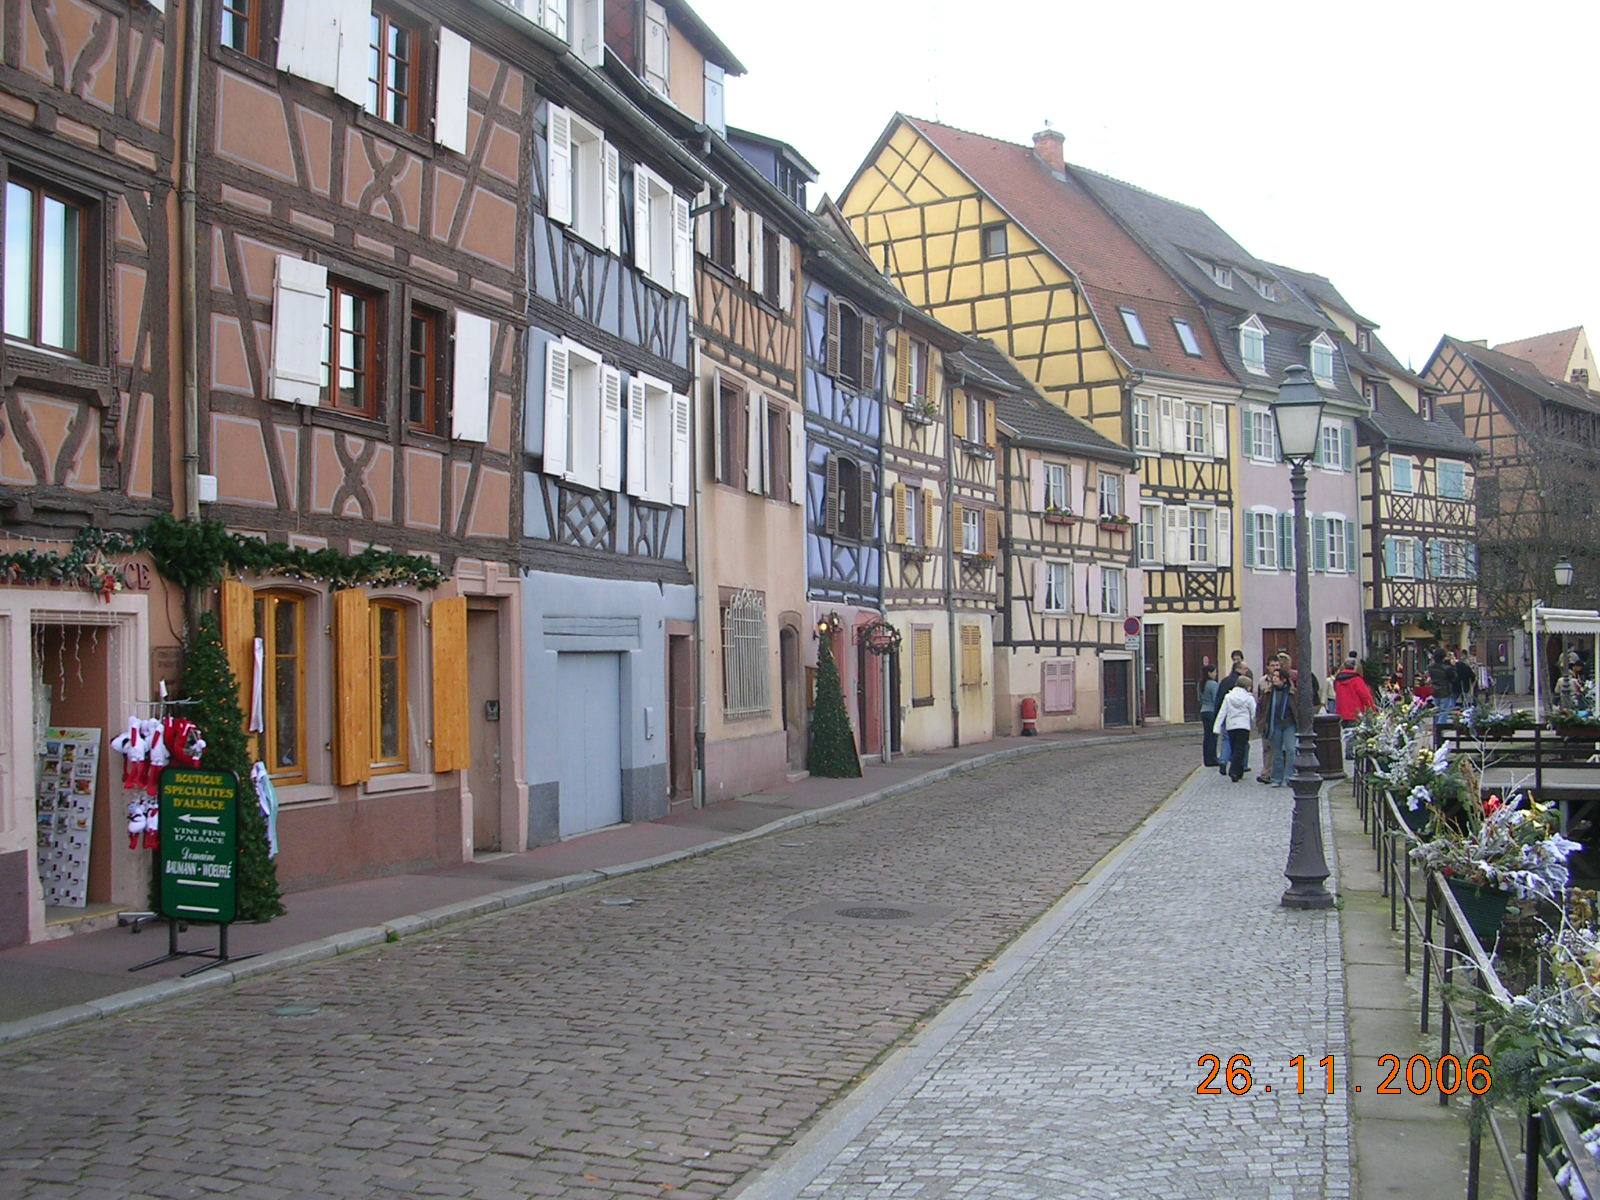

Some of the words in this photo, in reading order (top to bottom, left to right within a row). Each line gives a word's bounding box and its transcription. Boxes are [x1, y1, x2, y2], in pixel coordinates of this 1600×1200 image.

[175, 774, 223, 785] BOUTIQUE
[174, 798, 225, 810] D'ALSACE
[174, 827, 199, 835] VINS
[202, 829, 226, 837] FINS
[175, 834, 225, 844] D'ALSACE
